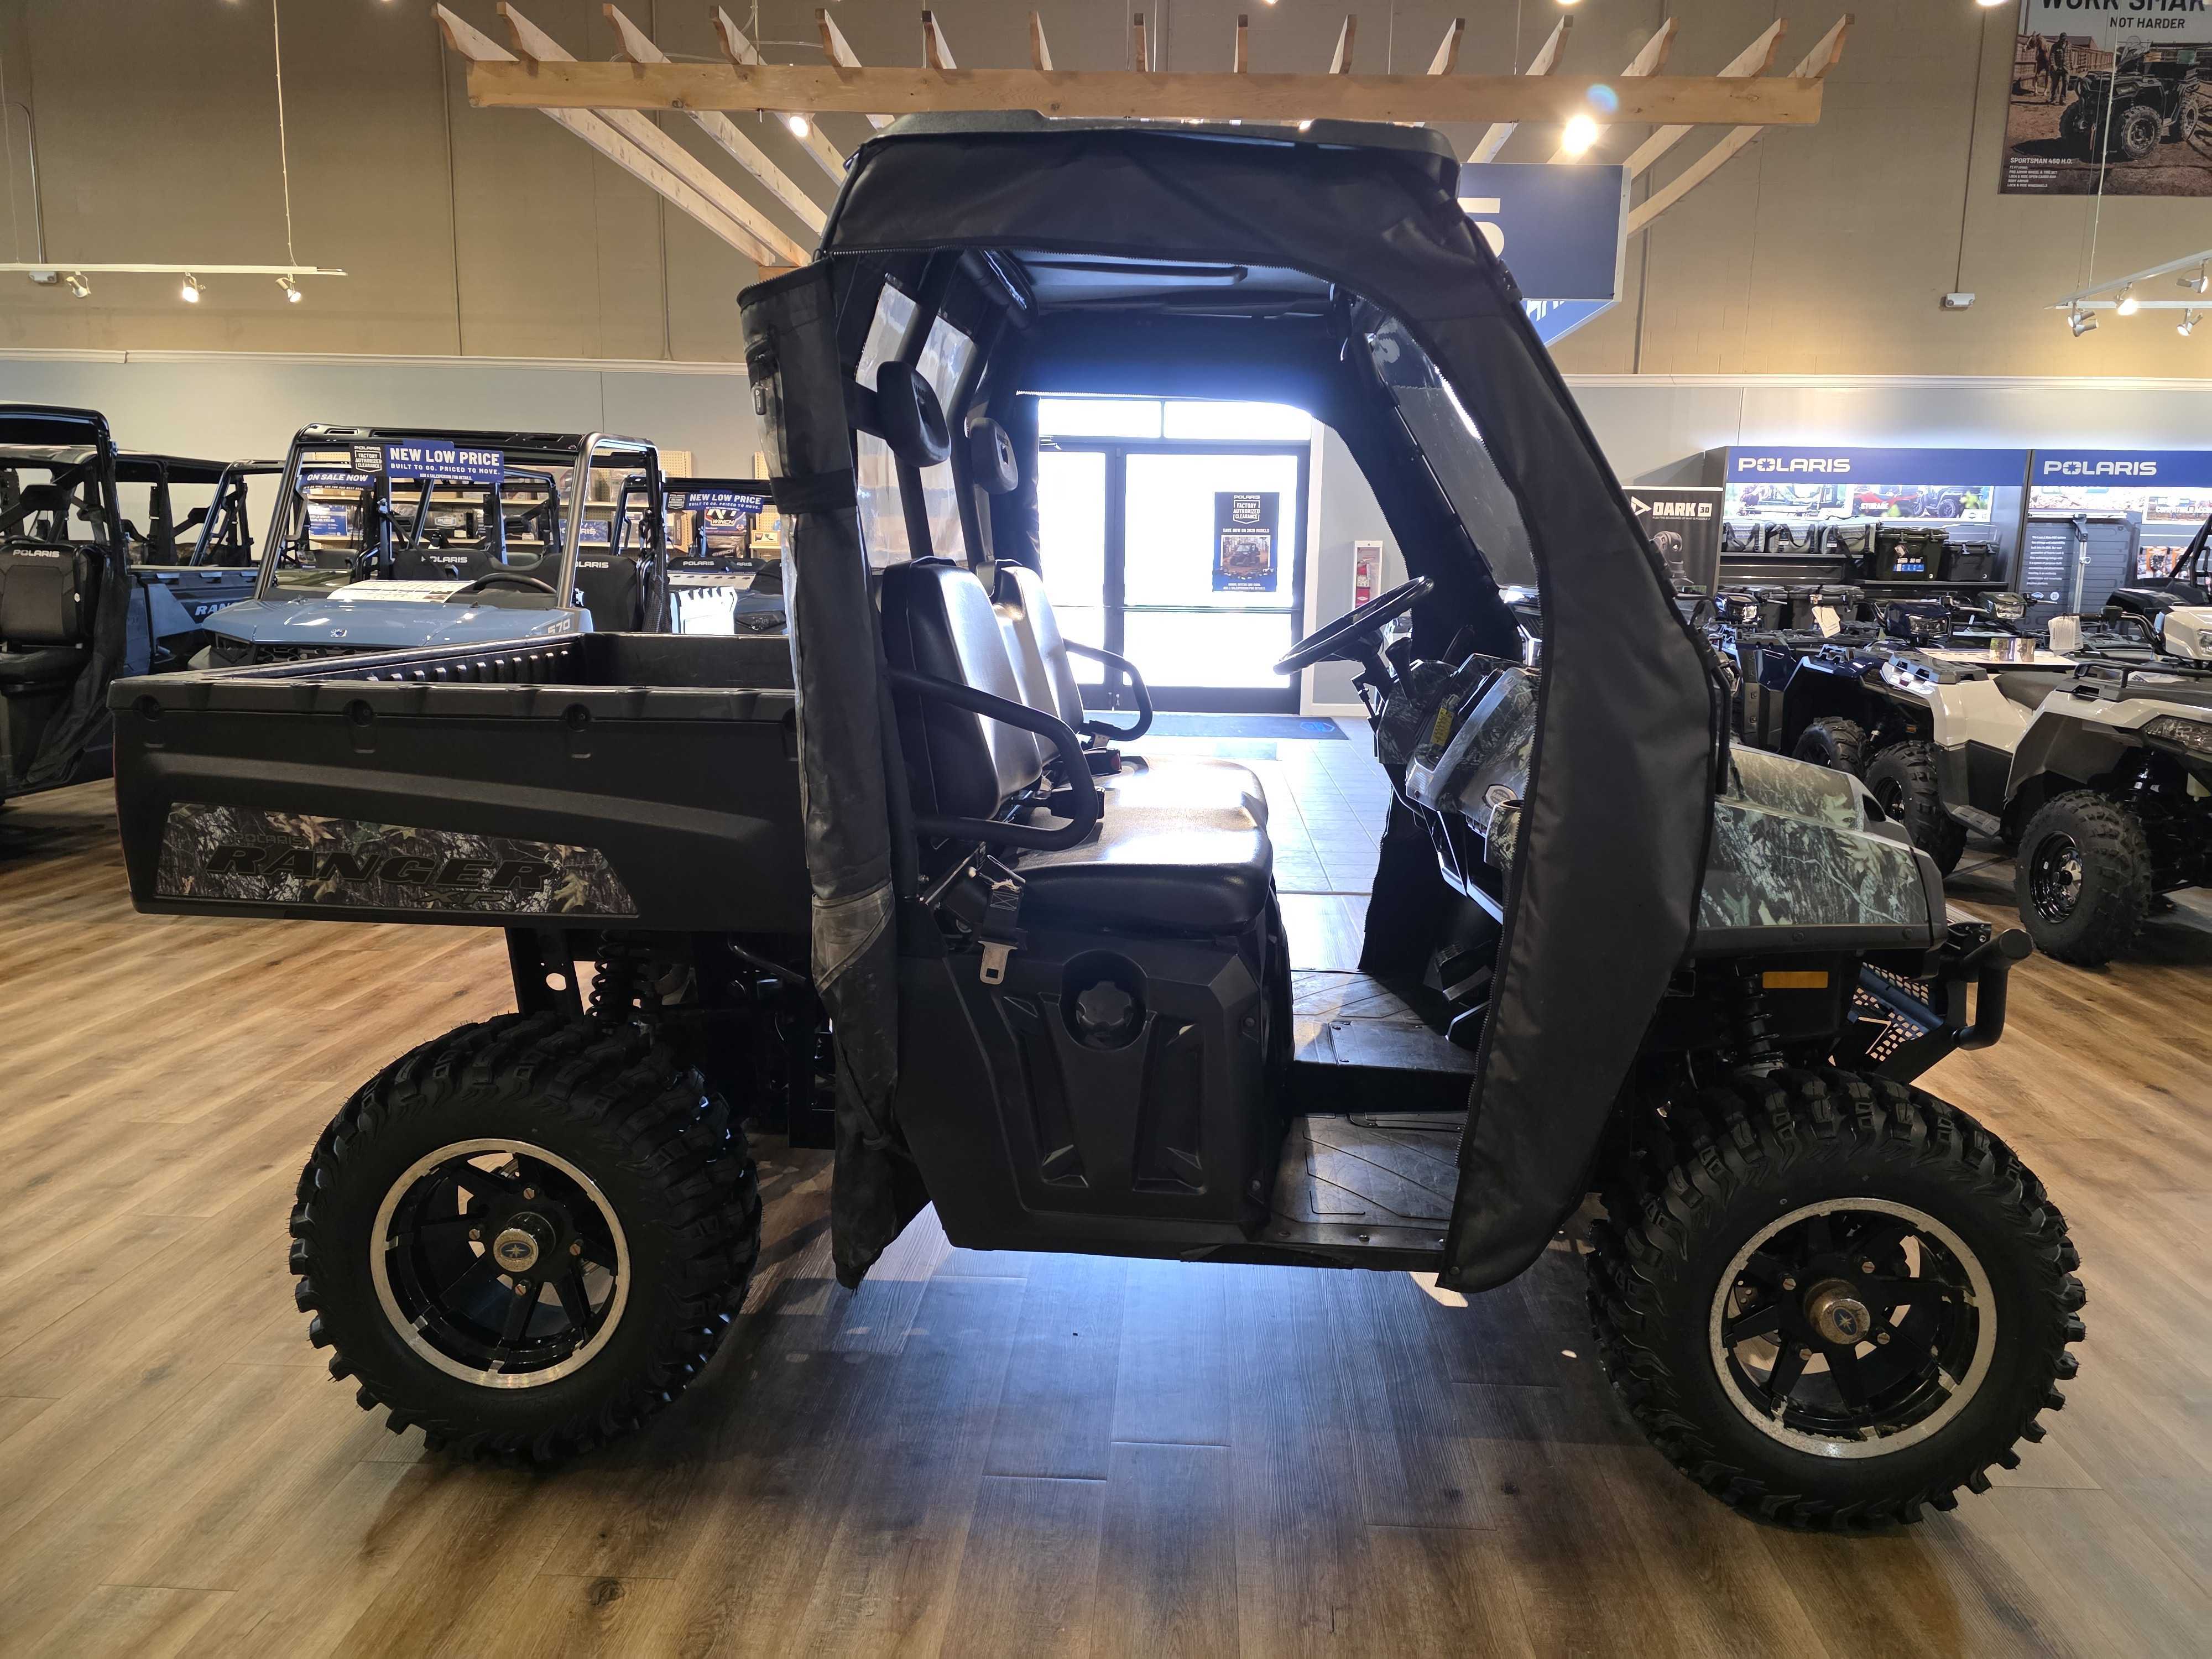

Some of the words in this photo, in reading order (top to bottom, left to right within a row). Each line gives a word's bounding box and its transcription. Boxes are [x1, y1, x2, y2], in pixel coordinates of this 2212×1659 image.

[2110, 17, 2134, 28] NOT
[2137, 18, 2185, 29] HARDER
[390, 447, 421, 461] NEW
[426, 450, 455, 463] LOW
[460, 451, 500, 466] PRICE
[1738, 457, 1850, 473] POLARIS
[2043, 461, 2157, 476] POLARIS
[712, 494, 733, 502] LOW
[734, 495, 761, 504] PRICE
[1652, 502, 1697, 517] DARK
[13, 549, 60, 558] POLARIS
[547, 618, 570, 634] 570
[234, 833, 304, 846] POLARIS
[205, 843, 554, 891] RANGER
[416, 888, 507, 904] XP
